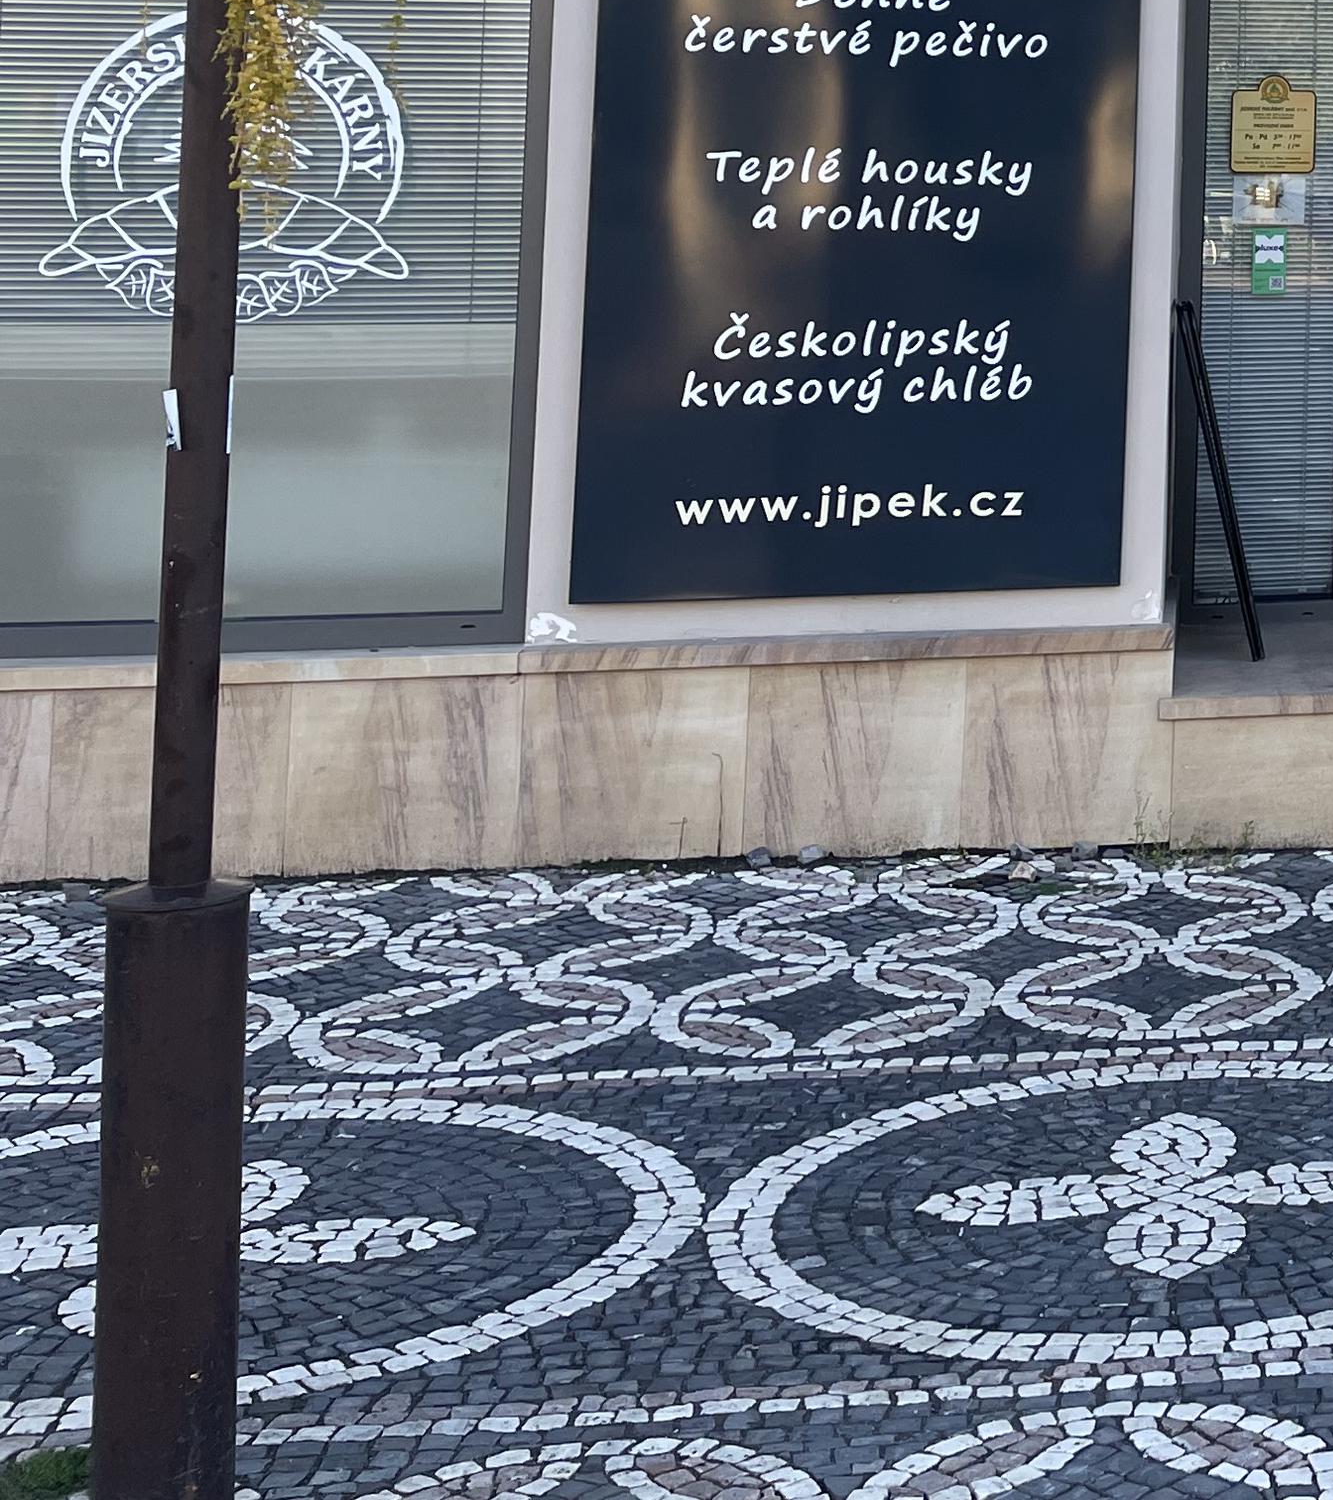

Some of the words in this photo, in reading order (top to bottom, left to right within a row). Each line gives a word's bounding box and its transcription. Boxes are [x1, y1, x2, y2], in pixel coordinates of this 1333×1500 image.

[683, 14, 873, 57] čerstvé
[888, 20, 1049, 66] pečivo
[705, 146, 843, 195] Teplé
[861, 148, 1034, 196] housky
[751, 205, 778, 231] a
[799, 194, 981, 242] rohlíky
[712, 311, 1012, 368] Českolipský
[680, 367, 884, 414] kvasový
[902, 363, 1033, 402] chléb
[674, 483, 1026, 529] www.jipek.cz
